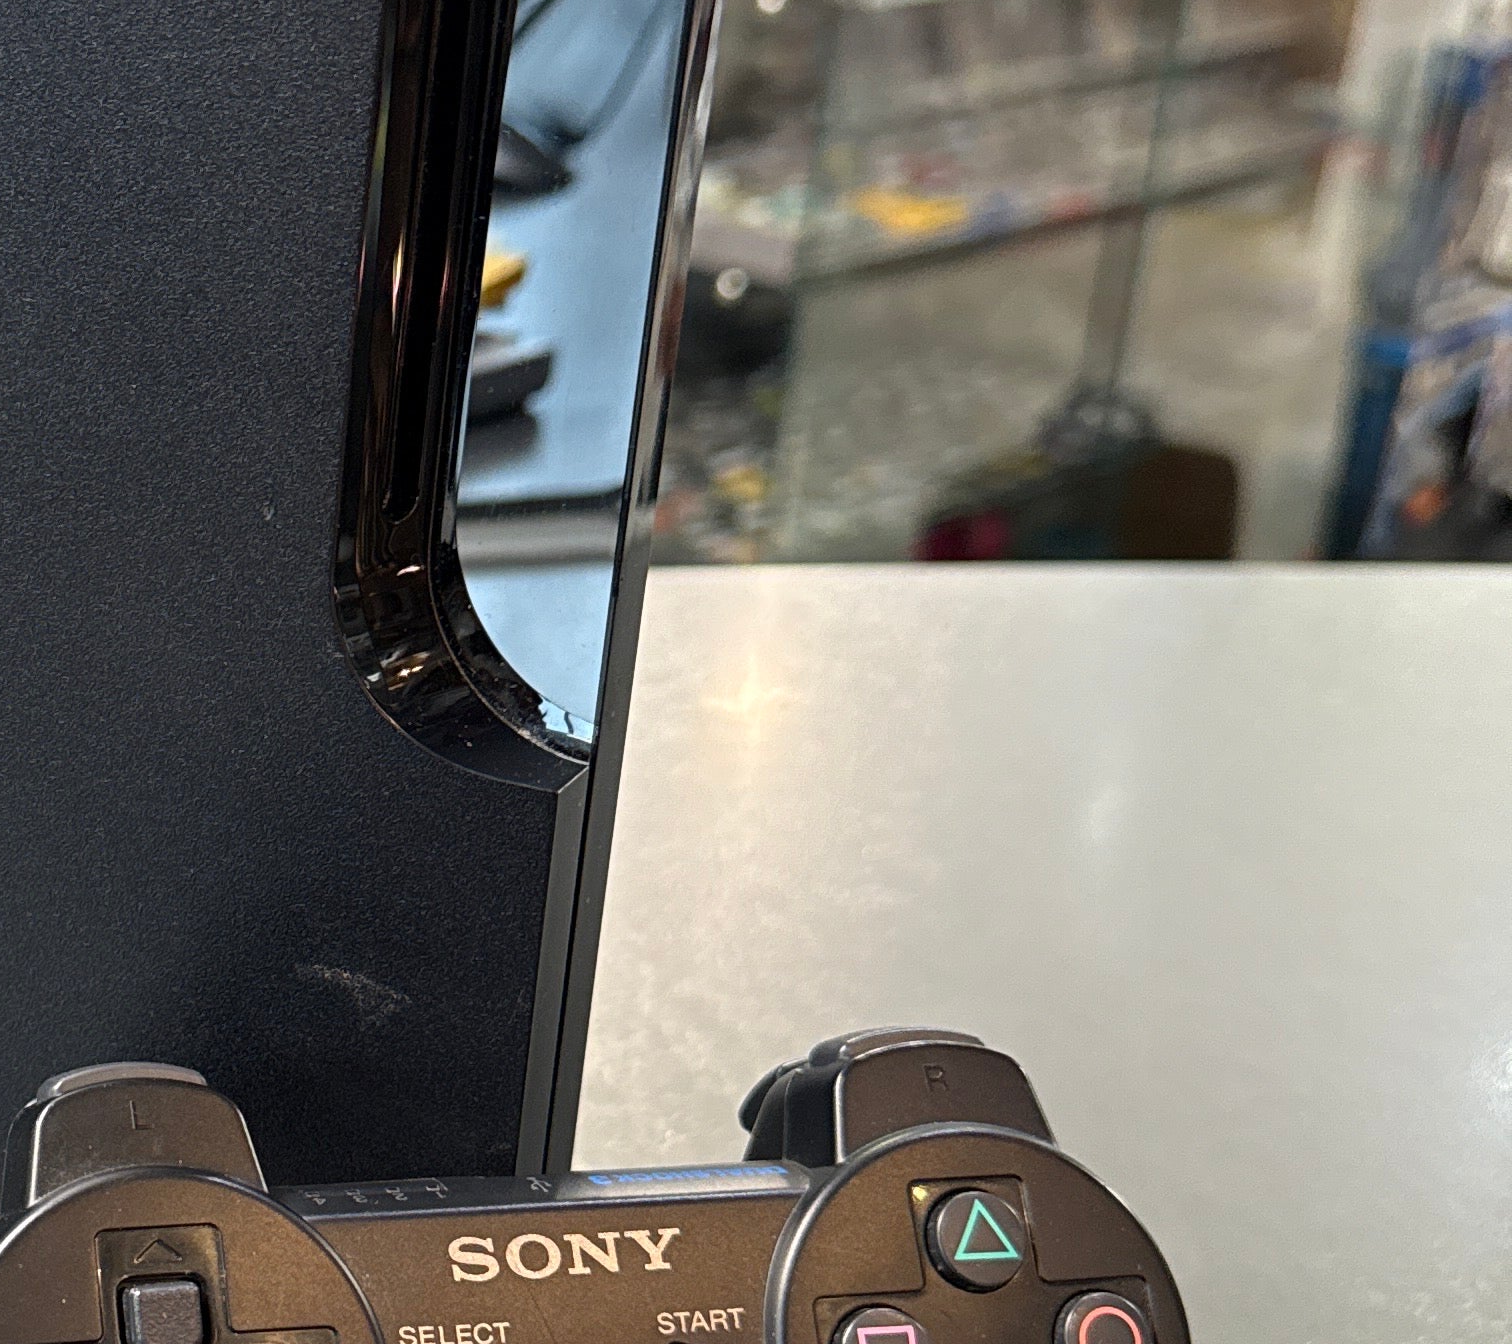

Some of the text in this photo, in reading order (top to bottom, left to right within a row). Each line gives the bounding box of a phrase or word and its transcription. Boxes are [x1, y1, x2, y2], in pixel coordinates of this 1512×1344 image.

[922, 1062, 949, 1092] R
[128, 1099, 155, 1131] L
[447, 1227, 680, 1283] SONY
[656, 1307, 745, 1335] START
